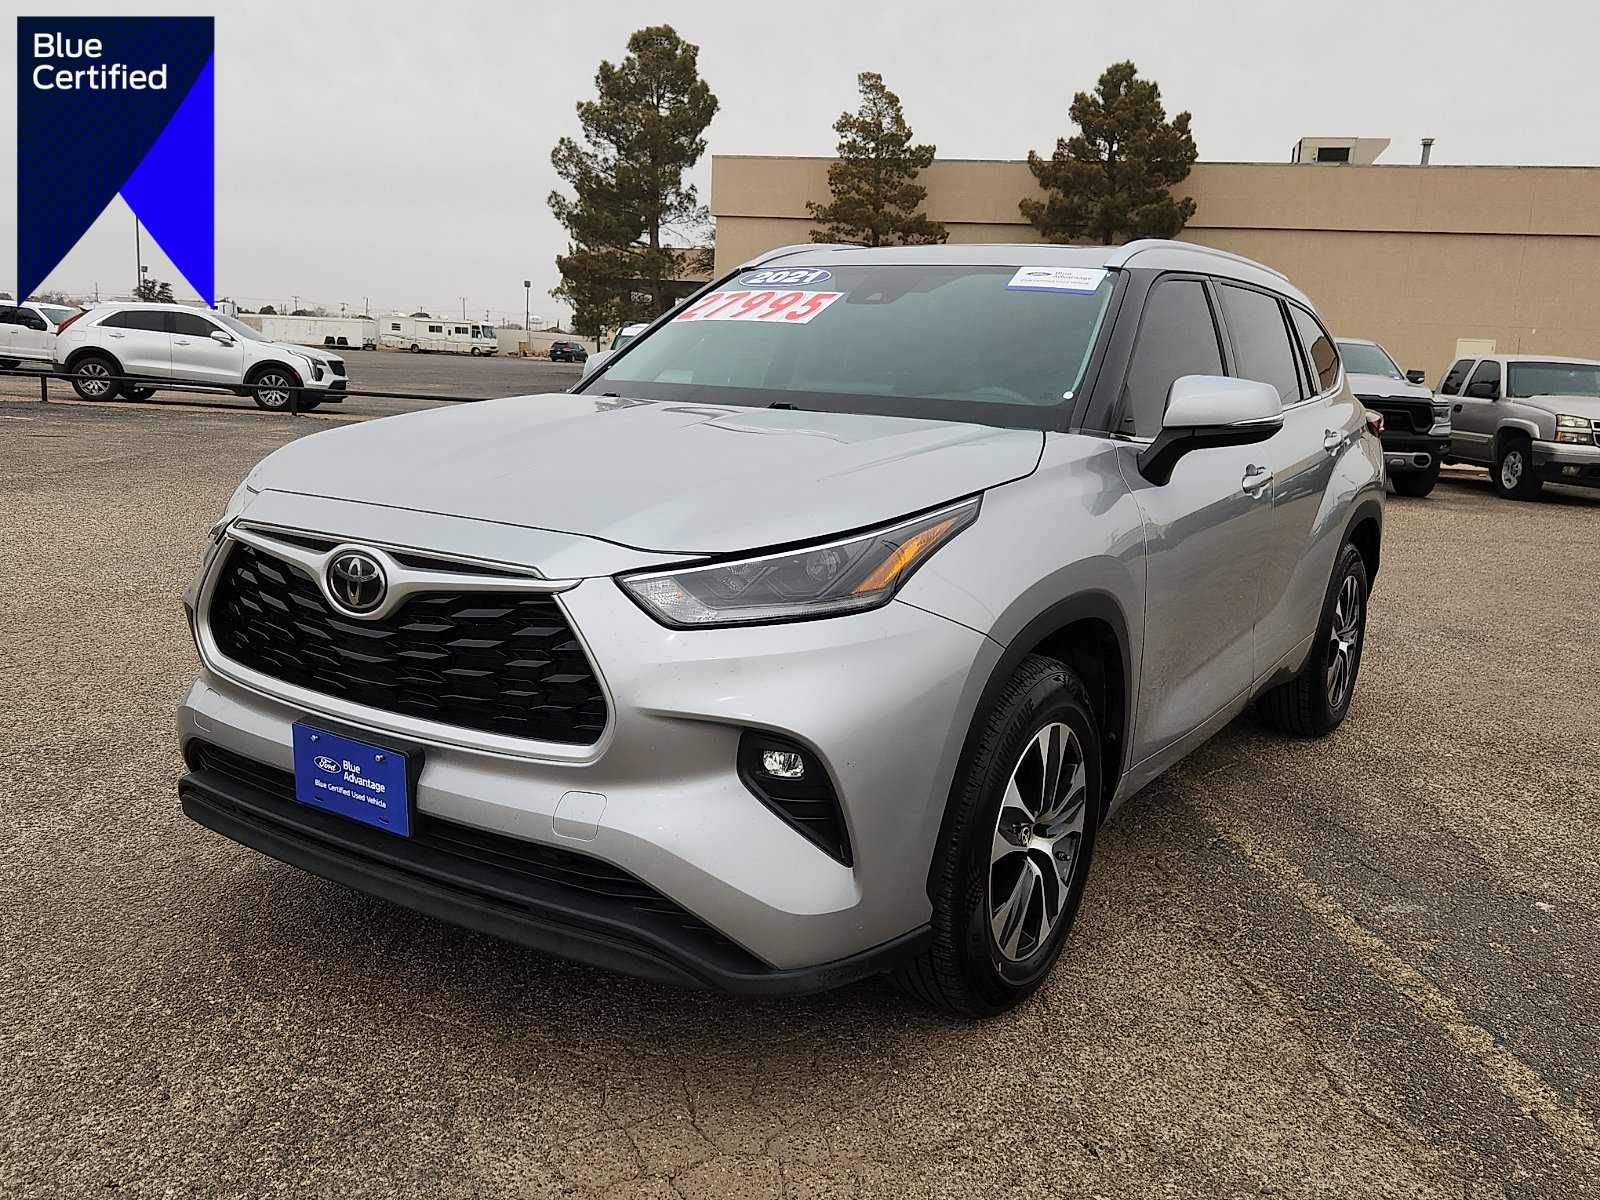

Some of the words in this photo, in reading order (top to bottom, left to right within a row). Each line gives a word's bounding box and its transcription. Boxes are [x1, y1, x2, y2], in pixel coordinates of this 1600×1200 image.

[748, 271, 819, 284] 2021
[677, 292, 838, 320] 27995
[343, 760, 360, 773] Blue
[315, 779, 327, 788] Blue
[328, 784, 350, 796] Certified
[351, 791, 365, 801] Used
[344, 772, 385, 792] Advantage
